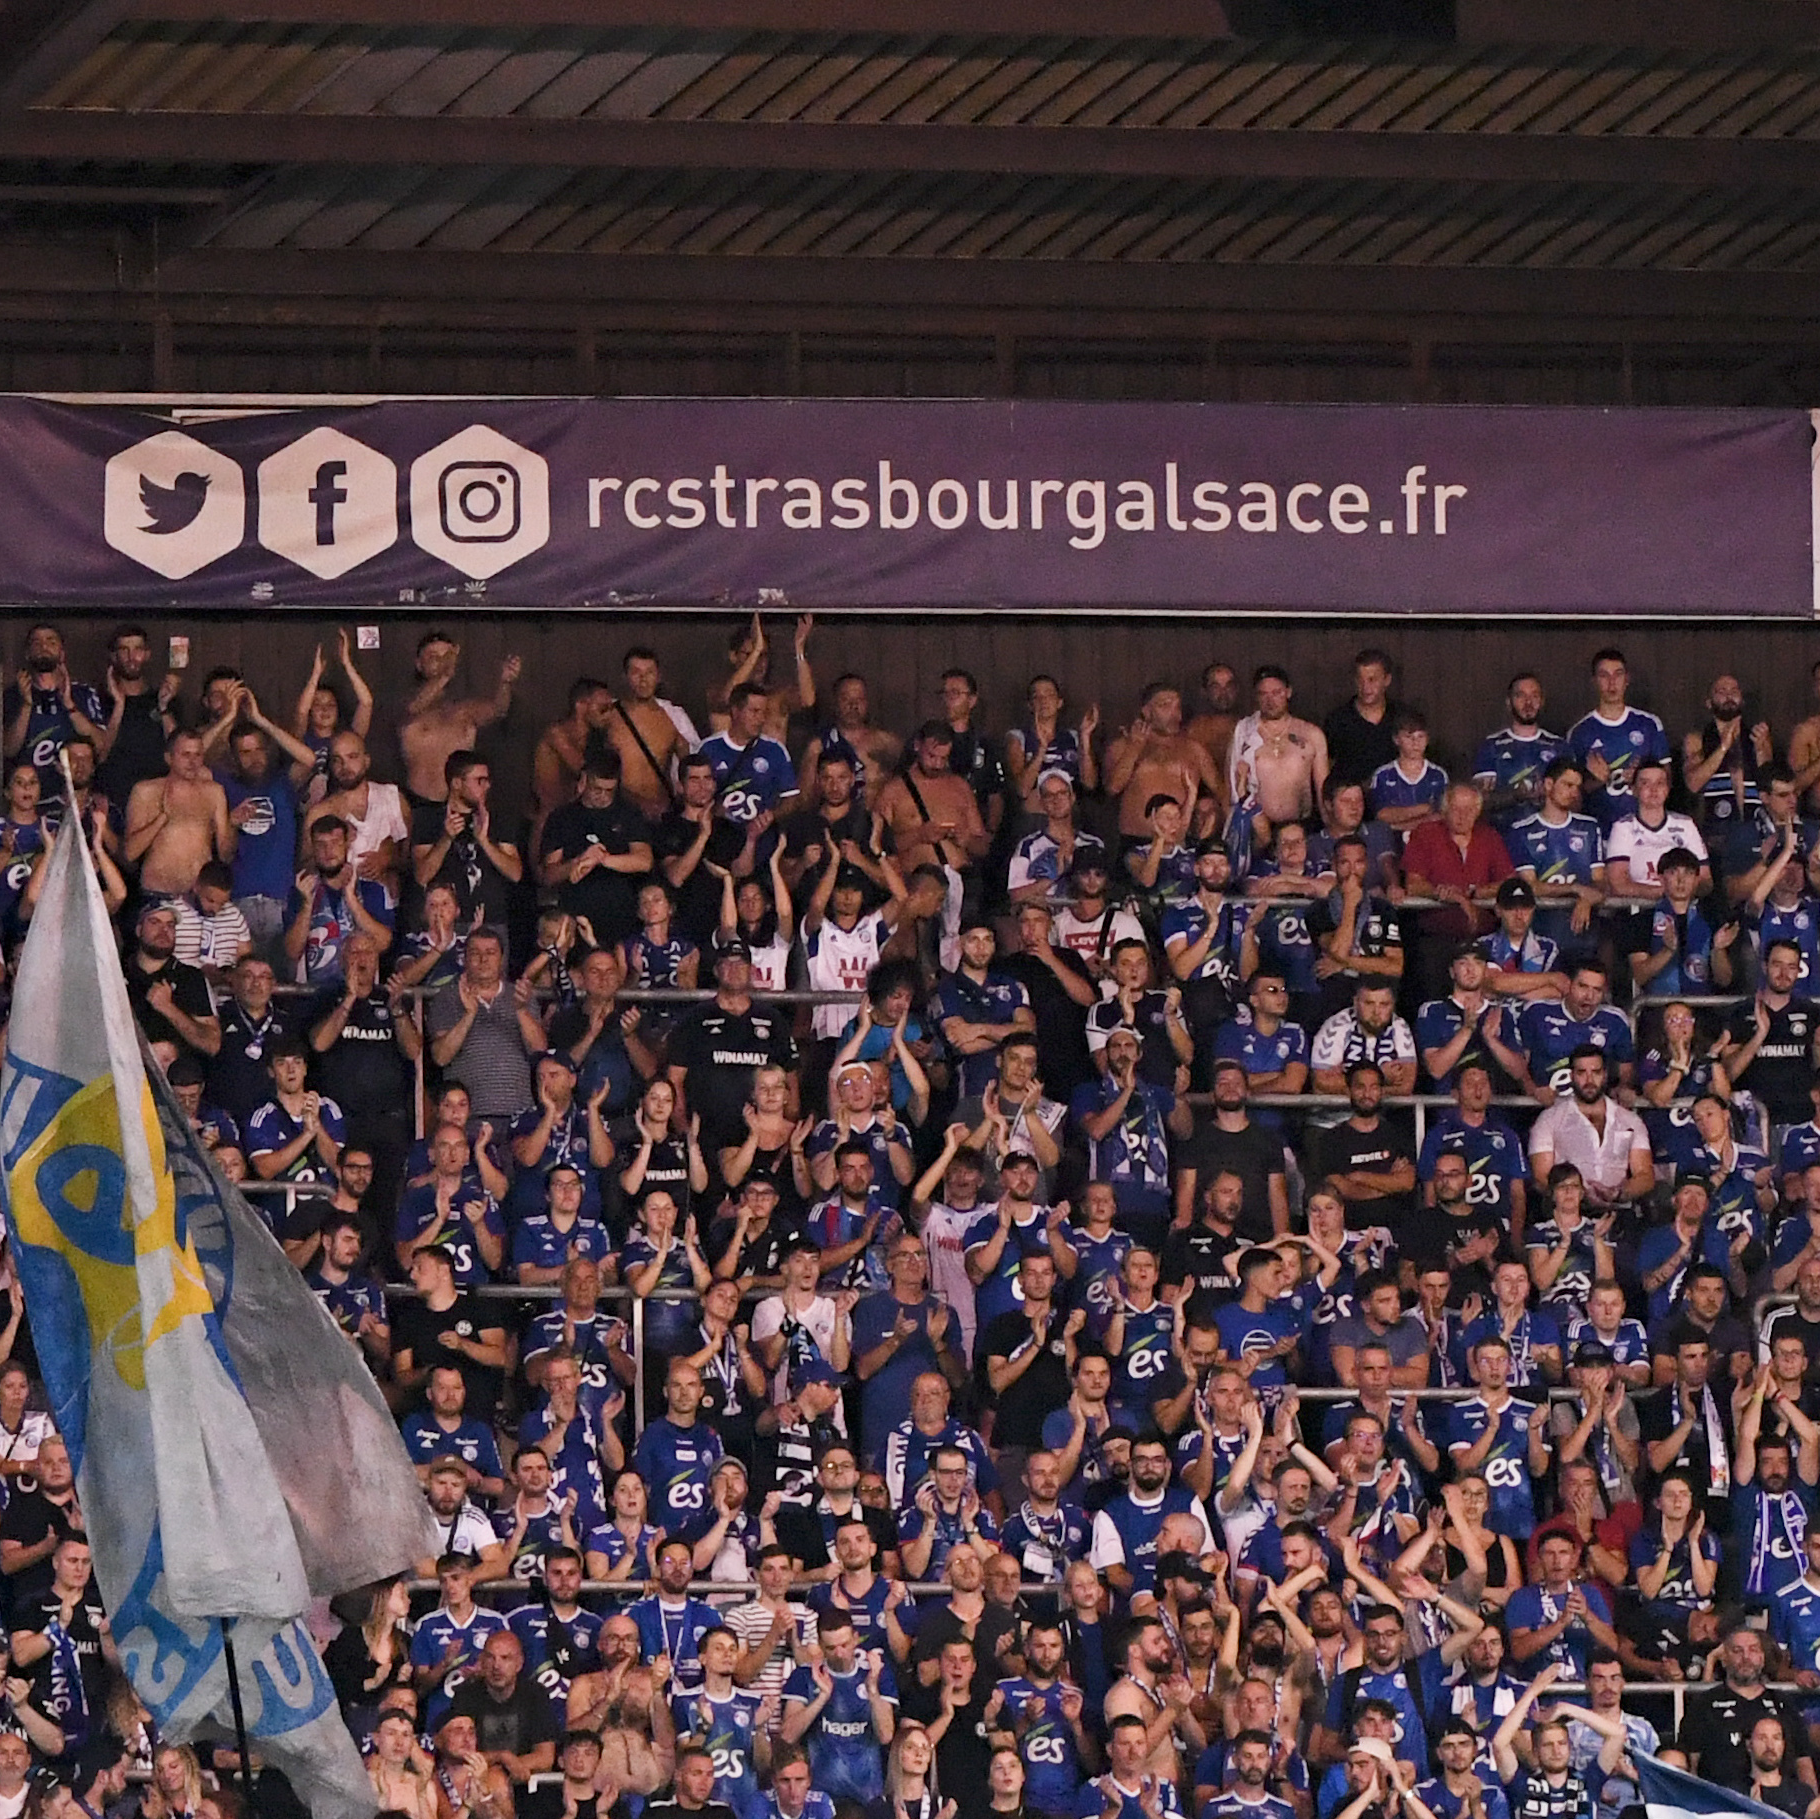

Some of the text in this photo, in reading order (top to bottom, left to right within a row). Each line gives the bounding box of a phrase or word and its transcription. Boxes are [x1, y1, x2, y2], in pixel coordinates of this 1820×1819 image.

[586, 461, 1469, 550] rcstrasbourgalsace.fr
[1485, 1455, 1523, 1485] es
[668, 1476, 705, 1510] es
[821, 1719, 868, 1737] hager
[1027, 1734, 1064, 1764] es
